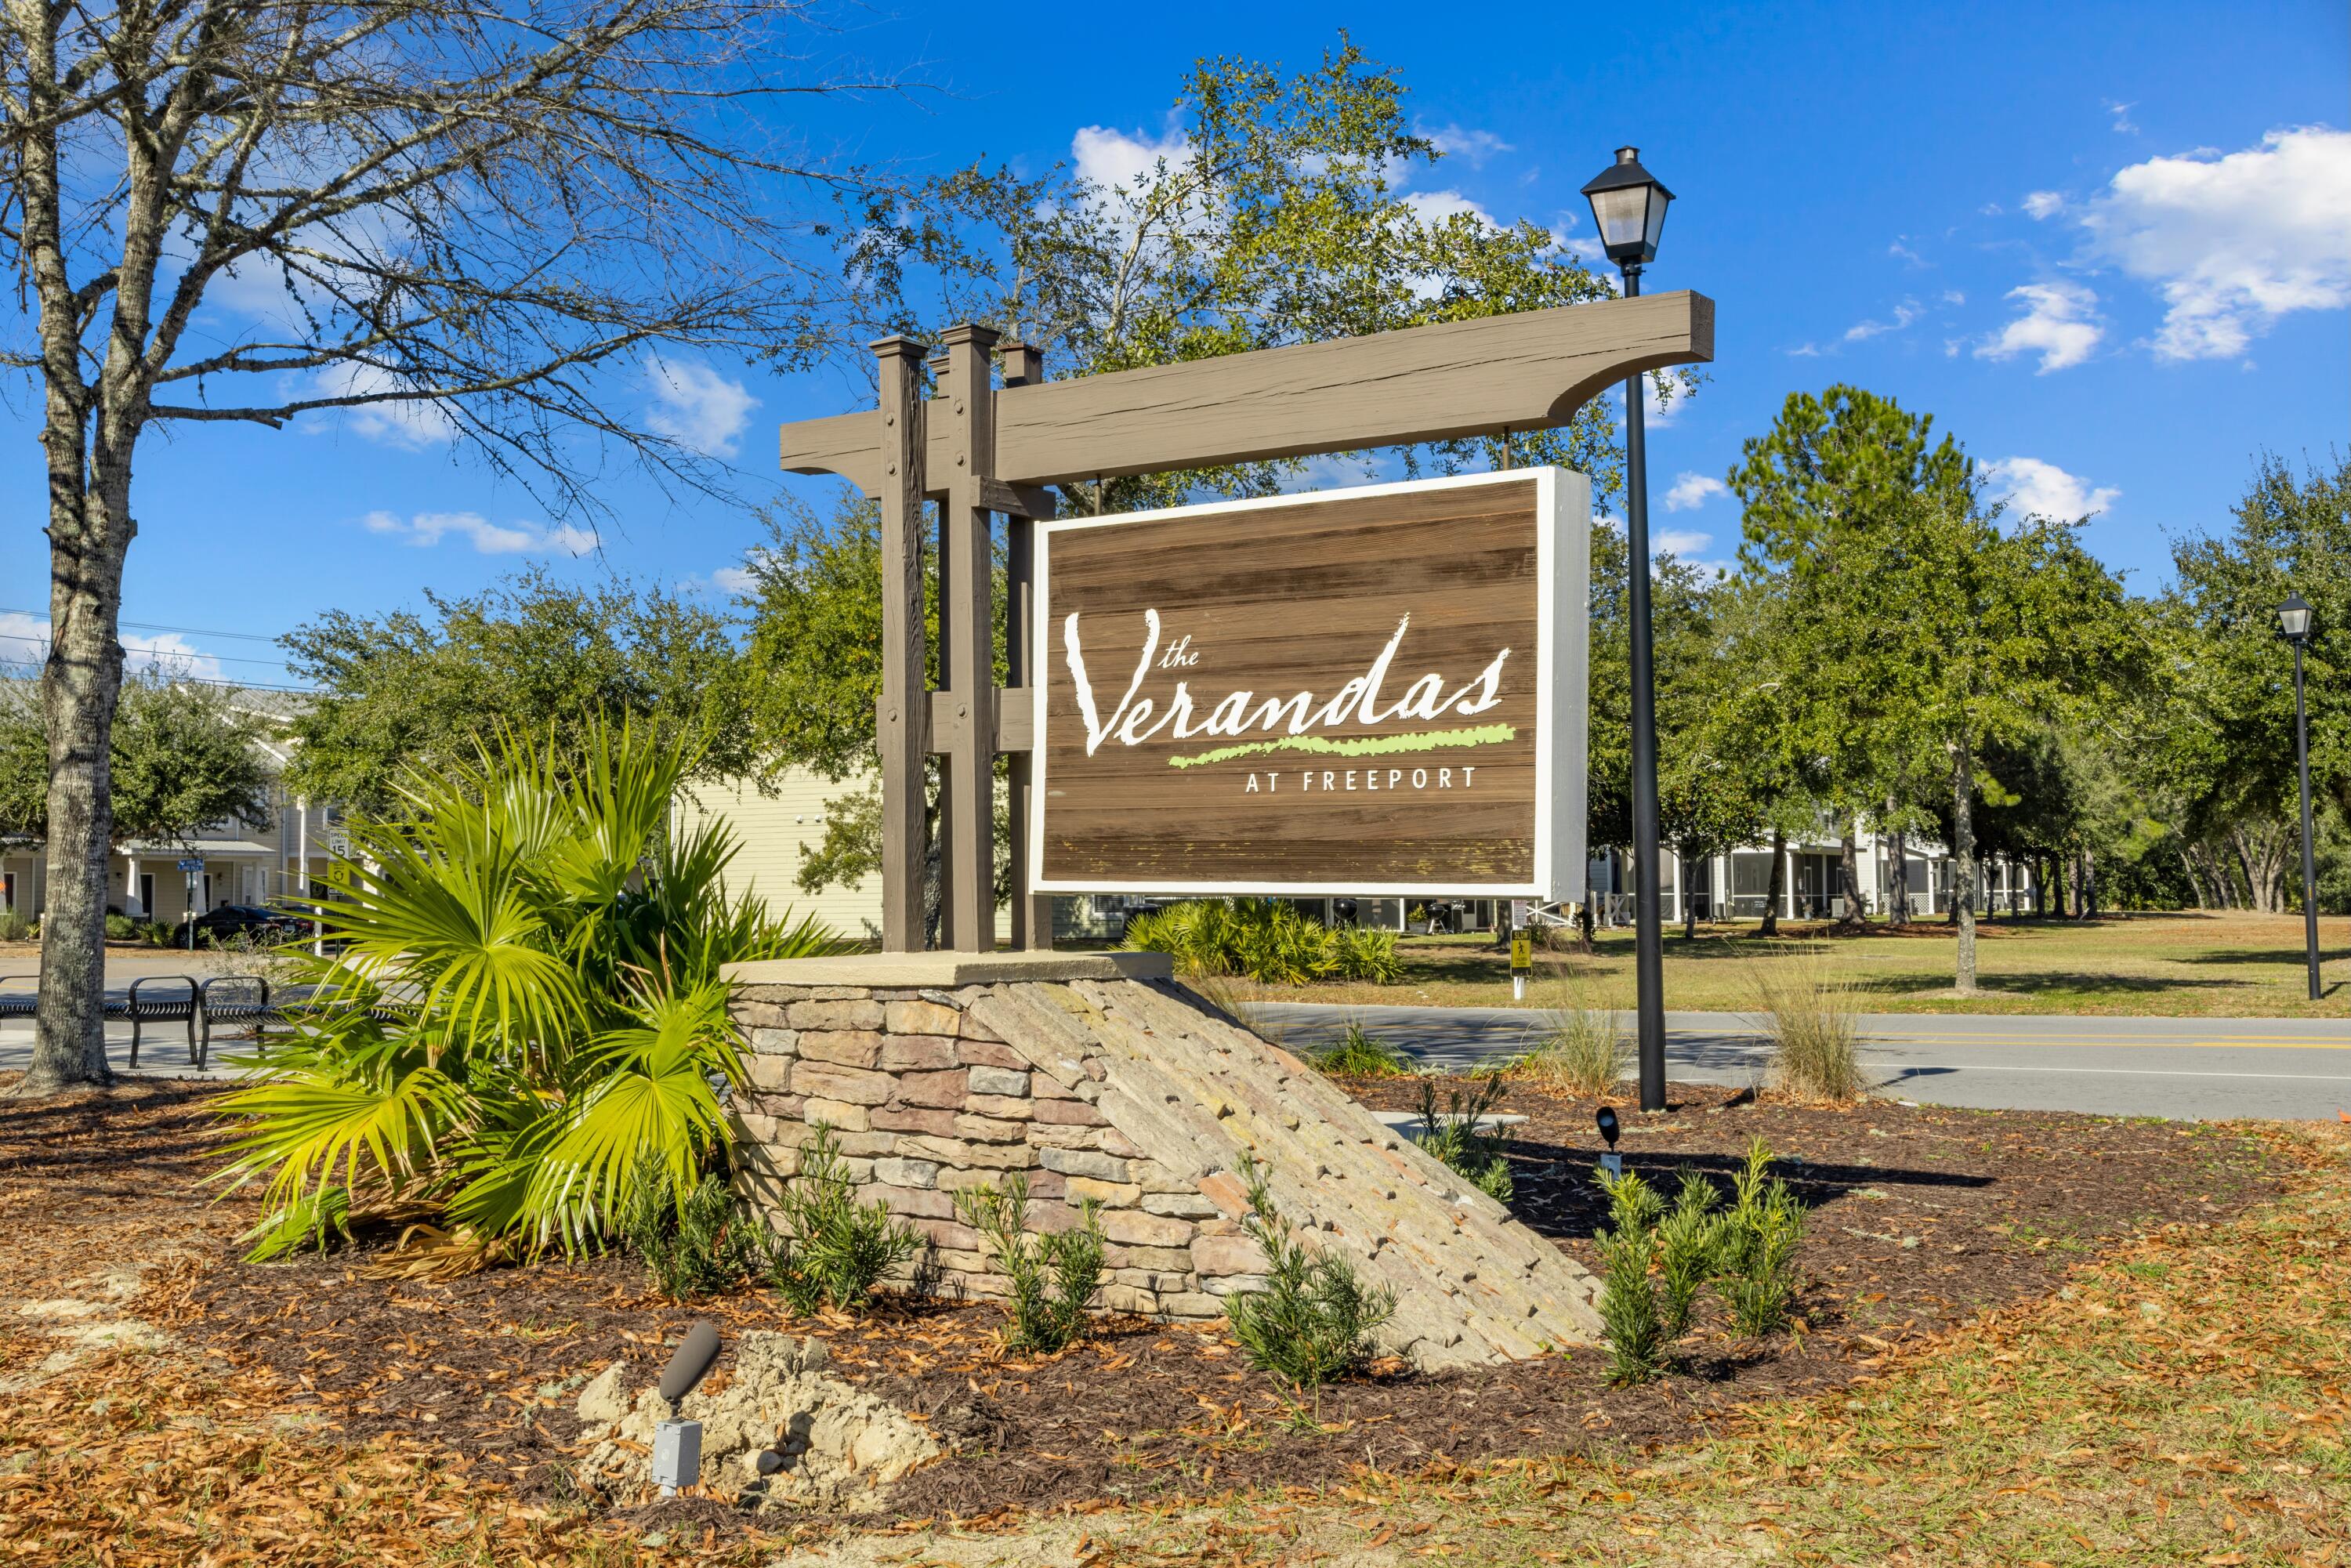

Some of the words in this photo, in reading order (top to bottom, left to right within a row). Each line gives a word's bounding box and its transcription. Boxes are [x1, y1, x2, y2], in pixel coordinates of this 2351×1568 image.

[1158, 635, 1199, 668] the
[1063, 608, 1512, 758] Verandas
[1245, 773, 1279, 792] AT
[1303, 767, 1475, 791] FREEPORT
[332, 846, 346, 857] 15
